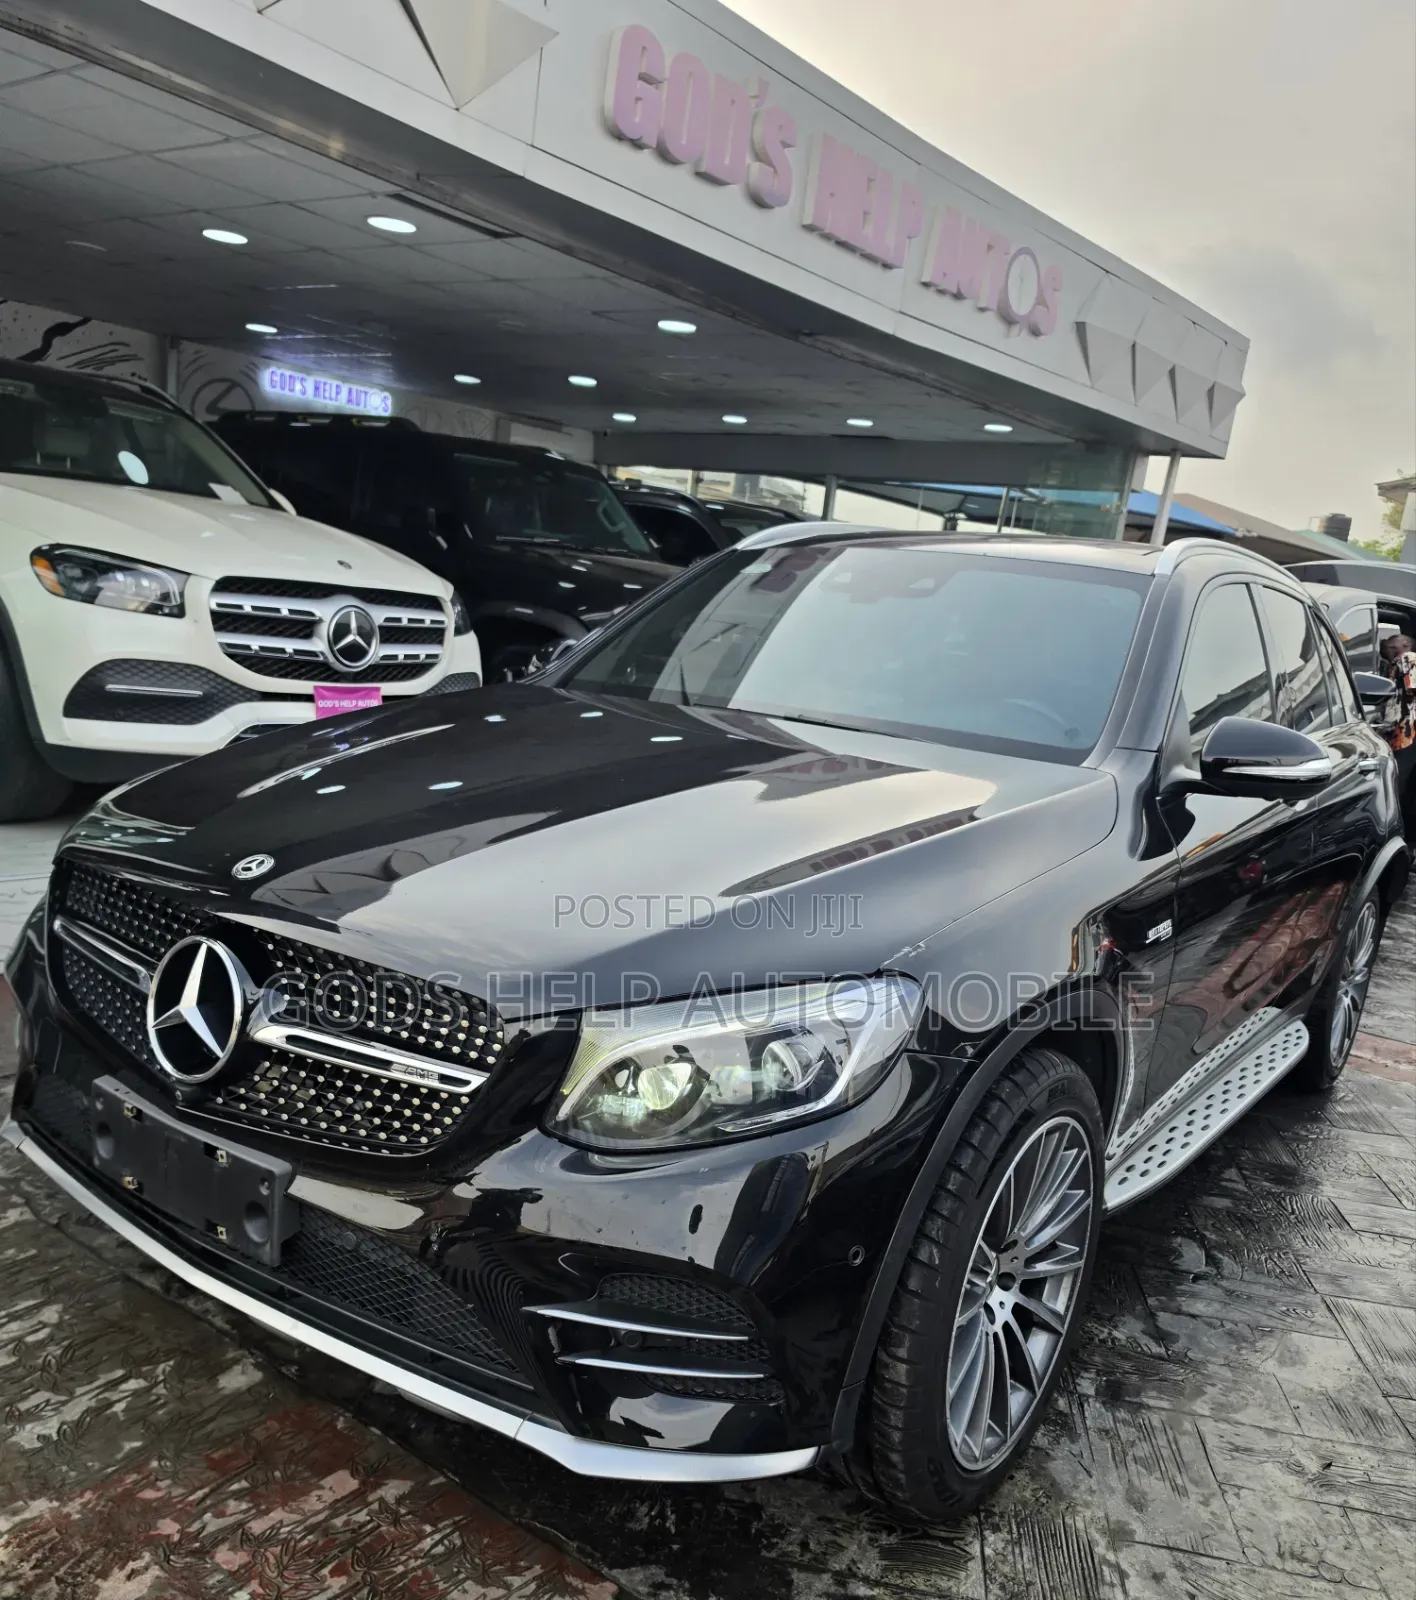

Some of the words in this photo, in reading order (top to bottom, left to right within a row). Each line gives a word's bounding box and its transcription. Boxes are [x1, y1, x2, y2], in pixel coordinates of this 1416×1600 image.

[605, 24, 797, 208] GOD'S
[804, 132, 924, 269] HELP
[922, 204, 1063, 337] AUTOS
[269, 370, 307, 396] GOD'S
[314, 378, 342, 402] HELP
[347, 387, 390, 413] AUTOS
[318, 700, 340, 708] GOD'S
